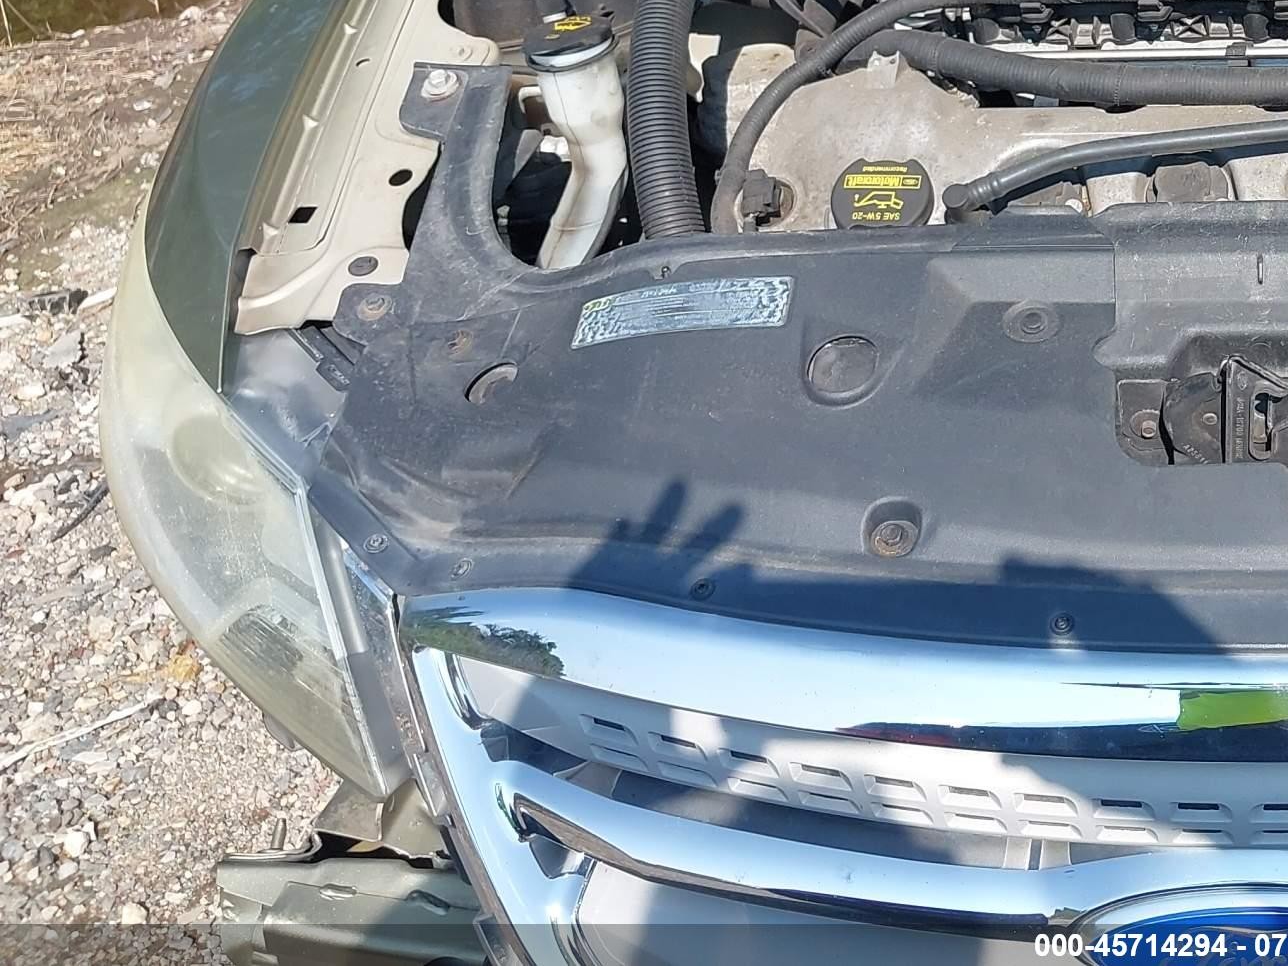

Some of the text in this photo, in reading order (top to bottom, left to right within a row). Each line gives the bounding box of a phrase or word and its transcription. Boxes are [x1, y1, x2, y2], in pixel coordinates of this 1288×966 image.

[847, 175, 901, 187] Motorcraft
[852, 211, 900, 221] SAE 5W-20
